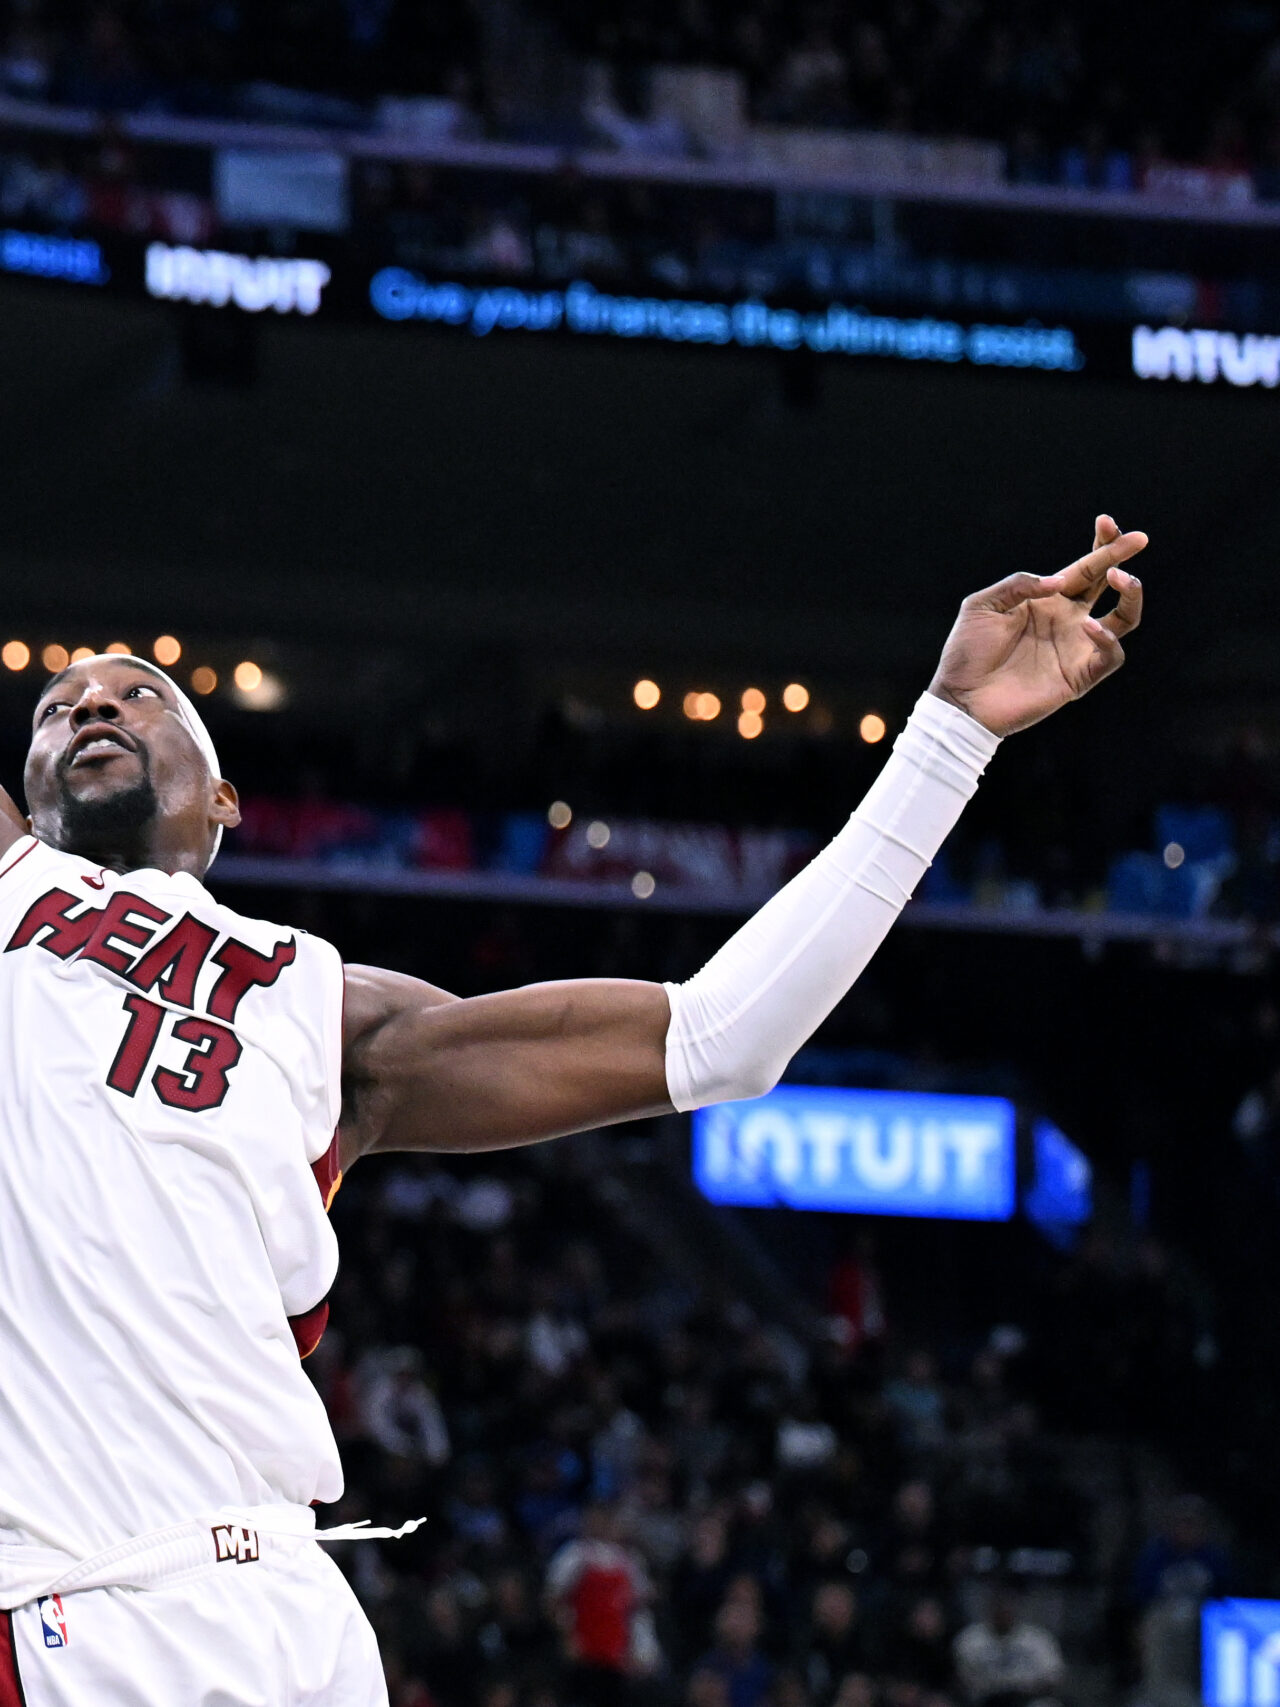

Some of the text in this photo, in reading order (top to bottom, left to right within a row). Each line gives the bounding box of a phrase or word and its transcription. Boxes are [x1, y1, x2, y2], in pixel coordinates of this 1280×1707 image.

[369, 266, 471, 324] Give
[470, 286, 563, 337] your
[2, 886, 297, 1025] HEAT
[105, 992, 244, 1113] 13
[46, 1634, 61, 1647] NBA
